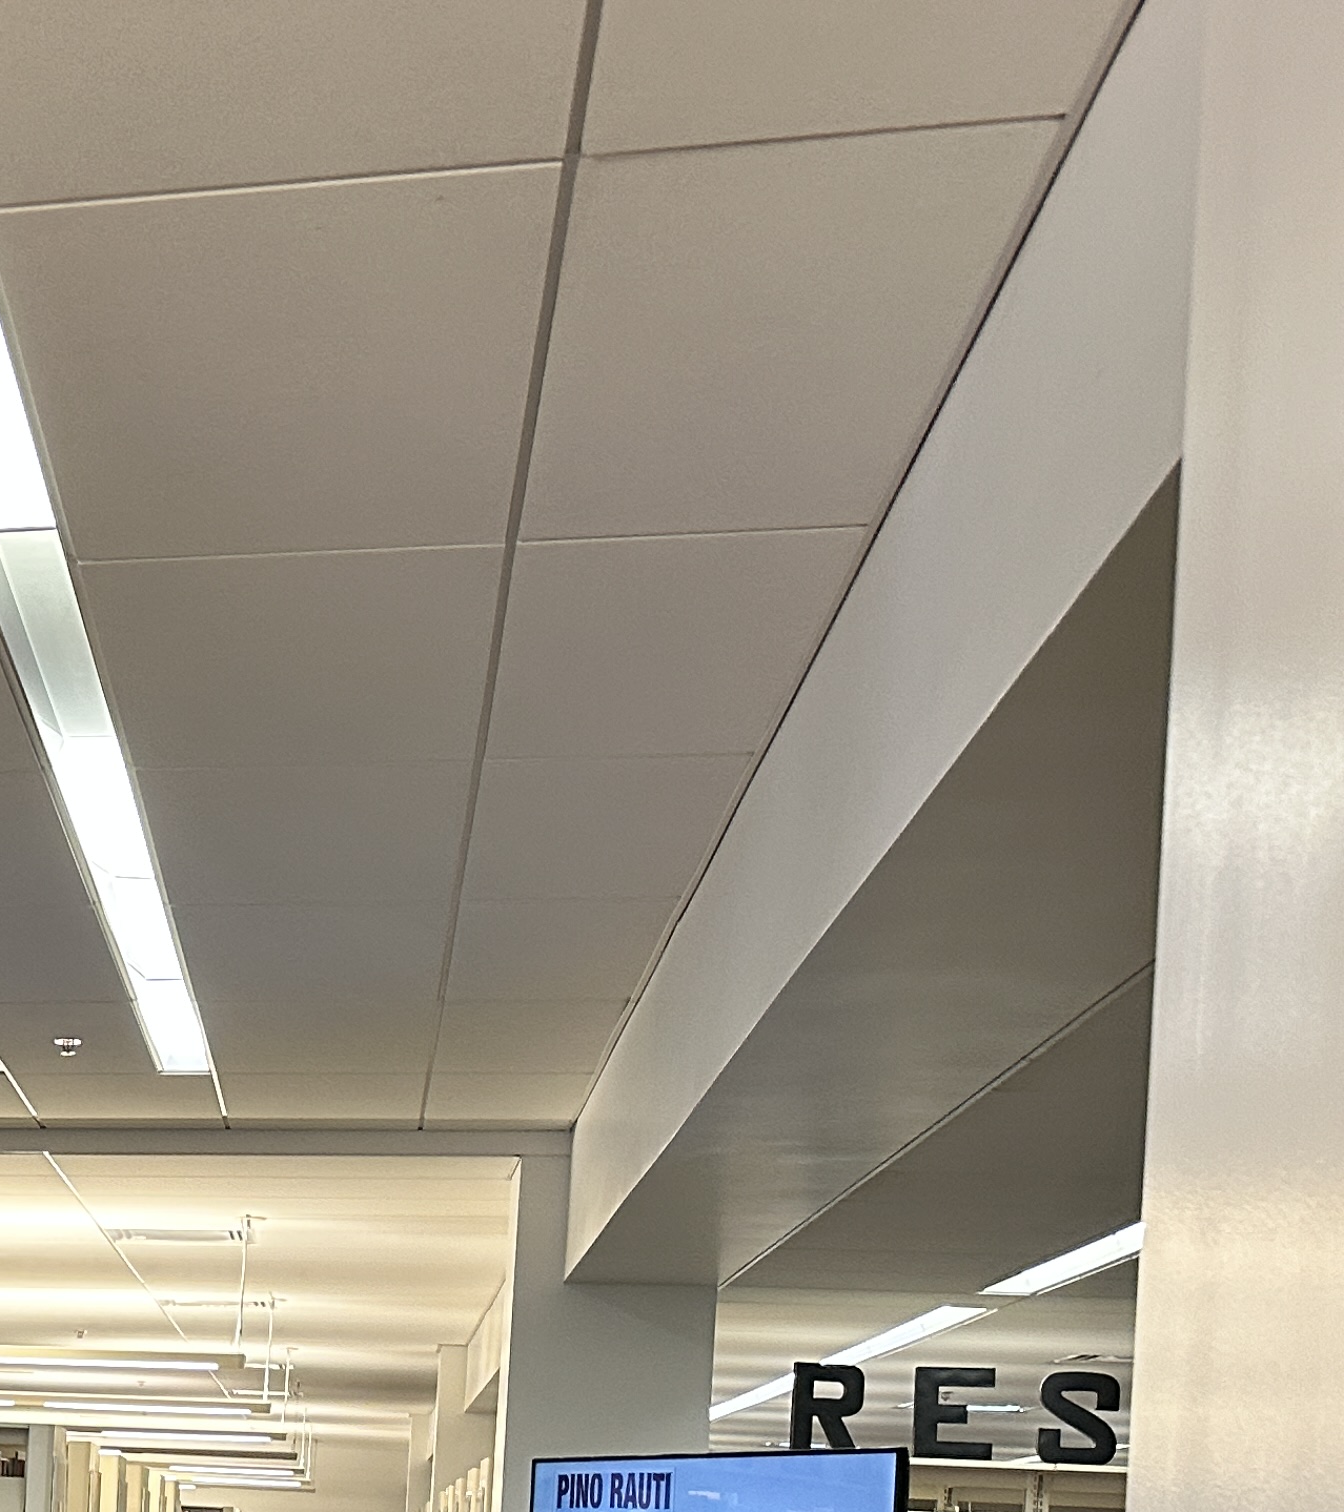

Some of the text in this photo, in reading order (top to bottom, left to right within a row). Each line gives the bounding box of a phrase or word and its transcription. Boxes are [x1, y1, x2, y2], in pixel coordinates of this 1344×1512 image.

[789, 1361, 1121, 1465] RES
[557, 1471, 673, 1510] PINO RAUTI
